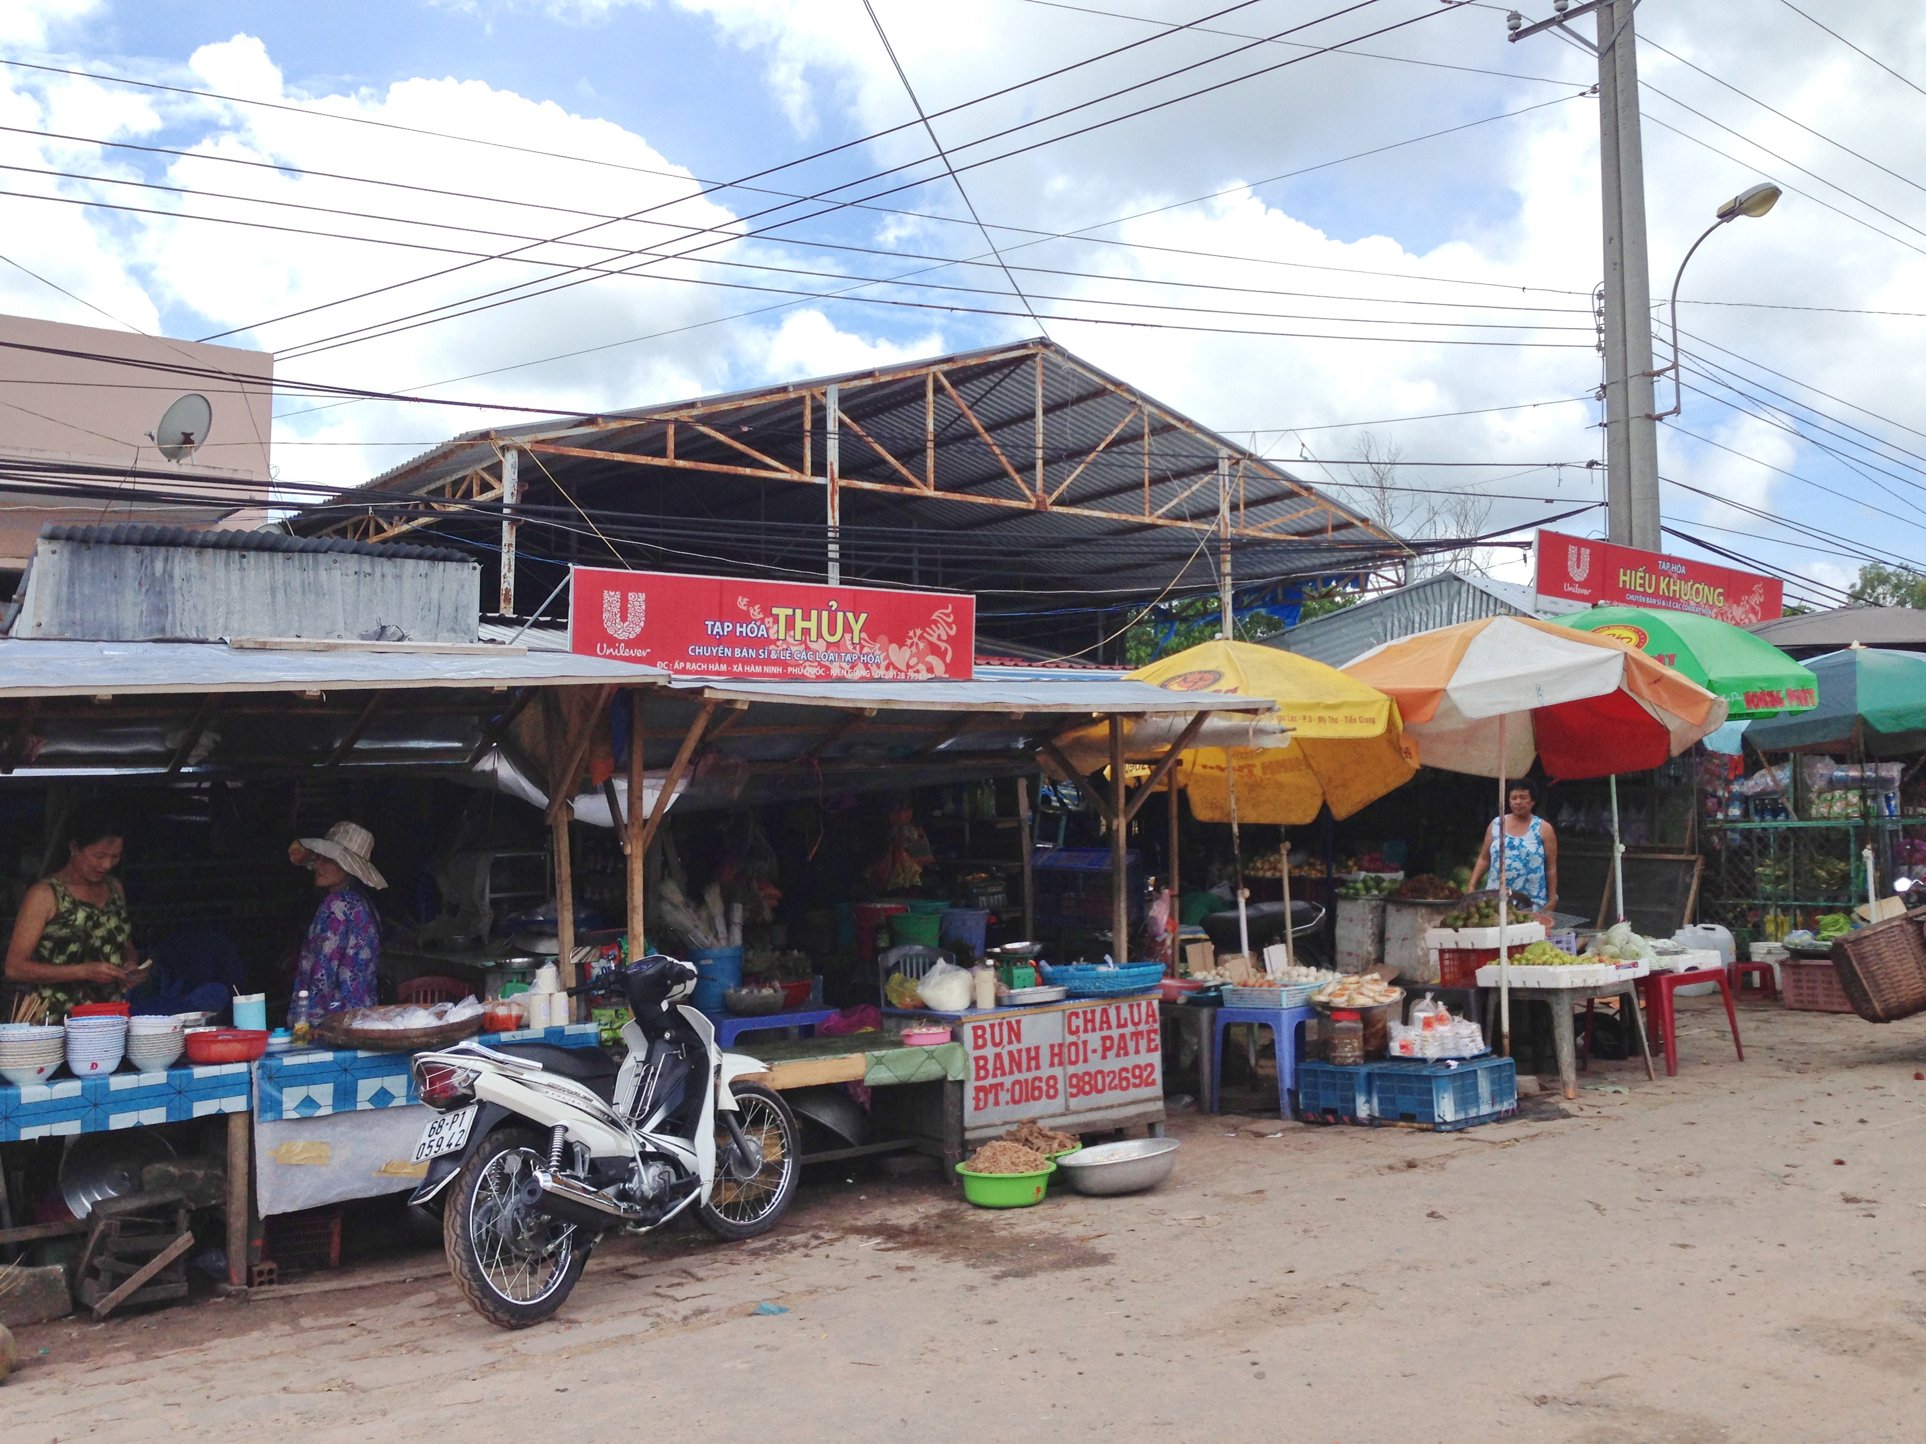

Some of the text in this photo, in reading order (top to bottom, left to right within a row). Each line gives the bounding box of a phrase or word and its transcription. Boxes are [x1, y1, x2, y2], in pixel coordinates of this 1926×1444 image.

[1659, 576, 1724, 607] KHƯƠNG
[704, 600, 868, 644] TẠP HÓA THỦY
[596, 643, 651, 657] Unilever
[688, 645, 732, 657] CHUYÊN
[734, 647, 755, 658] BÁN
[794, 650, 814, 661] CÁC
[816, 651, 838, 664] LOẠI
[840, 652, 858, 665] TẠP
[686, 663, 707, 672] RẠCH
[709, 663, 727, 672] HÀM
[745, 664, 762, 673] HÀM
[764, 666, 782, 674] NINH
[974, 1044, 1041, 1082] BÁNH
[1068, 1062, 1157, 1099] 9802692
[428, 1111, 466, 1138] 68-P1
[416, 1129, 465, 1160] 059.42
